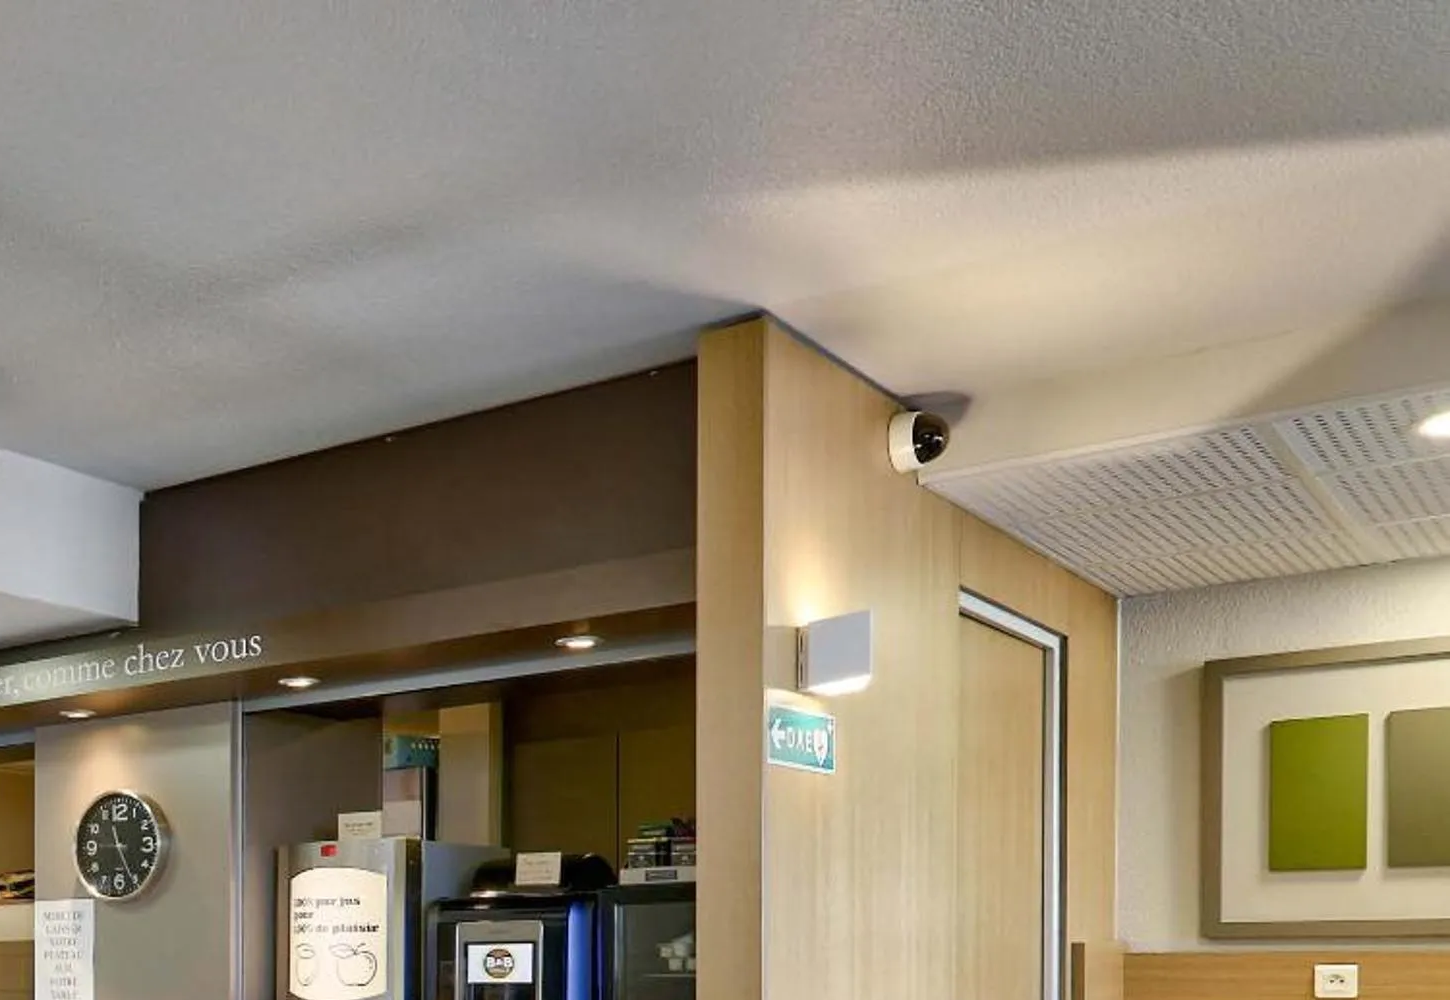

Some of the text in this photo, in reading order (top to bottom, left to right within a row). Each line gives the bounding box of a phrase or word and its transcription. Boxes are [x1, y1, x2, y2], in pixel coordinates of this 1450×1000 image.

[24, 658, 115, 691] comme
[124, 643, 185, 676] chez
[194, 635, 262, 664] vous
[112, 804, 129, 821] 12
[141, 819, 150, 830] 2
[86, 840, 98, 856] 9
[141, 837, 154, 853] 3
[113, 873, 126, 890] 6
